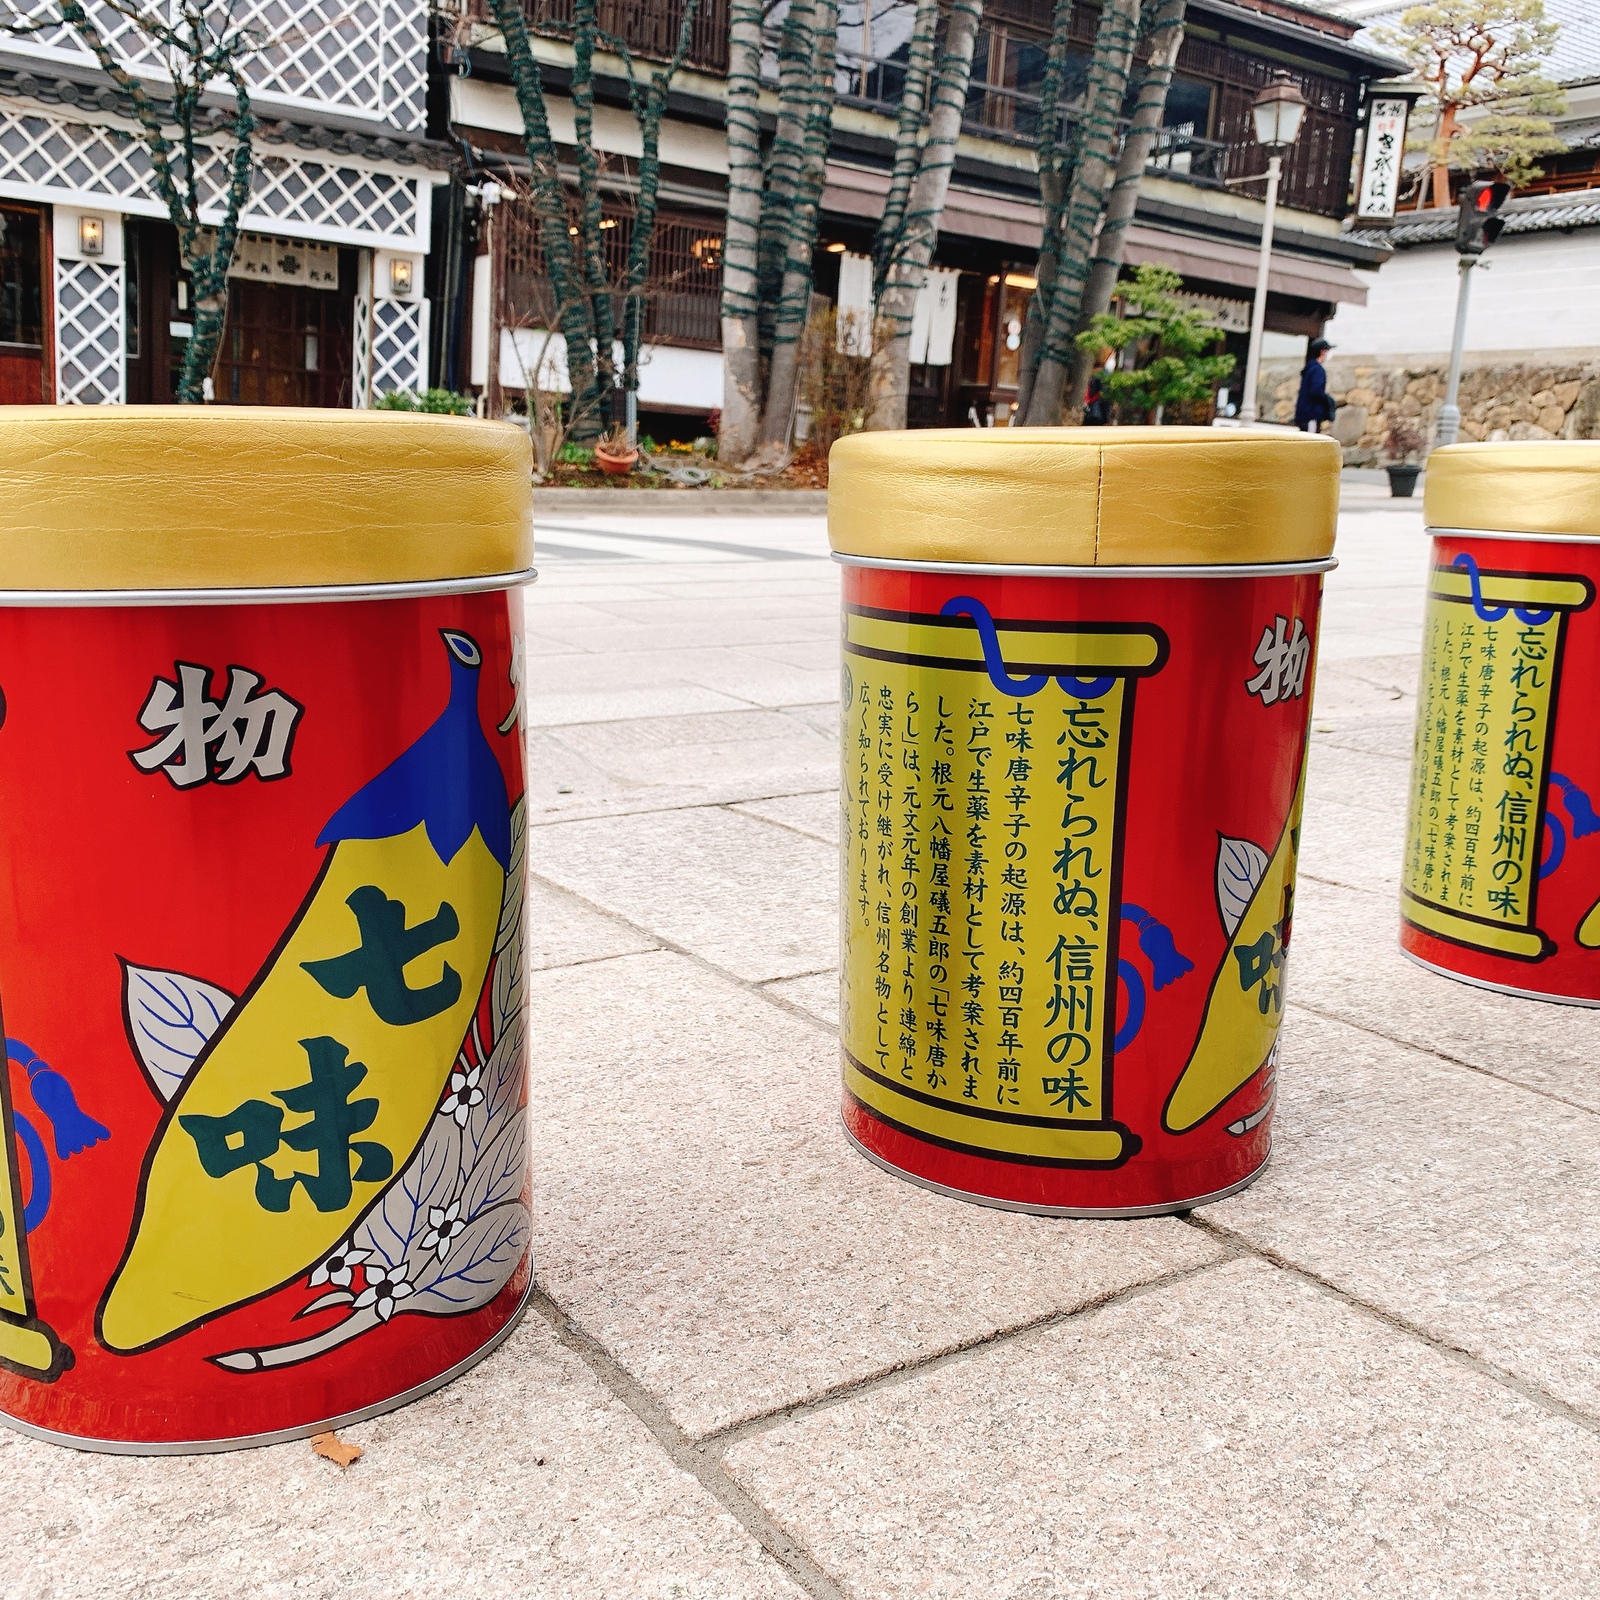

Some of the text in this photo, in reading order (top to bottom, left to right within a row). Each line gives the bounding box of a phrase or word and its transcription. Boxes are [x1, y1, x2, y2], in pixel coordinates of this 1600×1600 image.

[131, 660, 305, 788] 物
[857, 681, 871, 927] 広く知られております。
[1244, 613, 1311, 708] 物
[1487, 627, 1548, 918] 忘れられぬ、信州の味
[875, 685, 894, 1070] 忠実に受け継がれ、信州名物として
[960, 698, 995, 1101] 江戸で生薬を素材として考案されま
[996, 702, 1035, 1106] 七味唐辛子の起源は、約四百年前に
[1041, 701, 1110, 1114] 忘れられぬ、信州の味
[178, 884, 462, 1214] 七味
